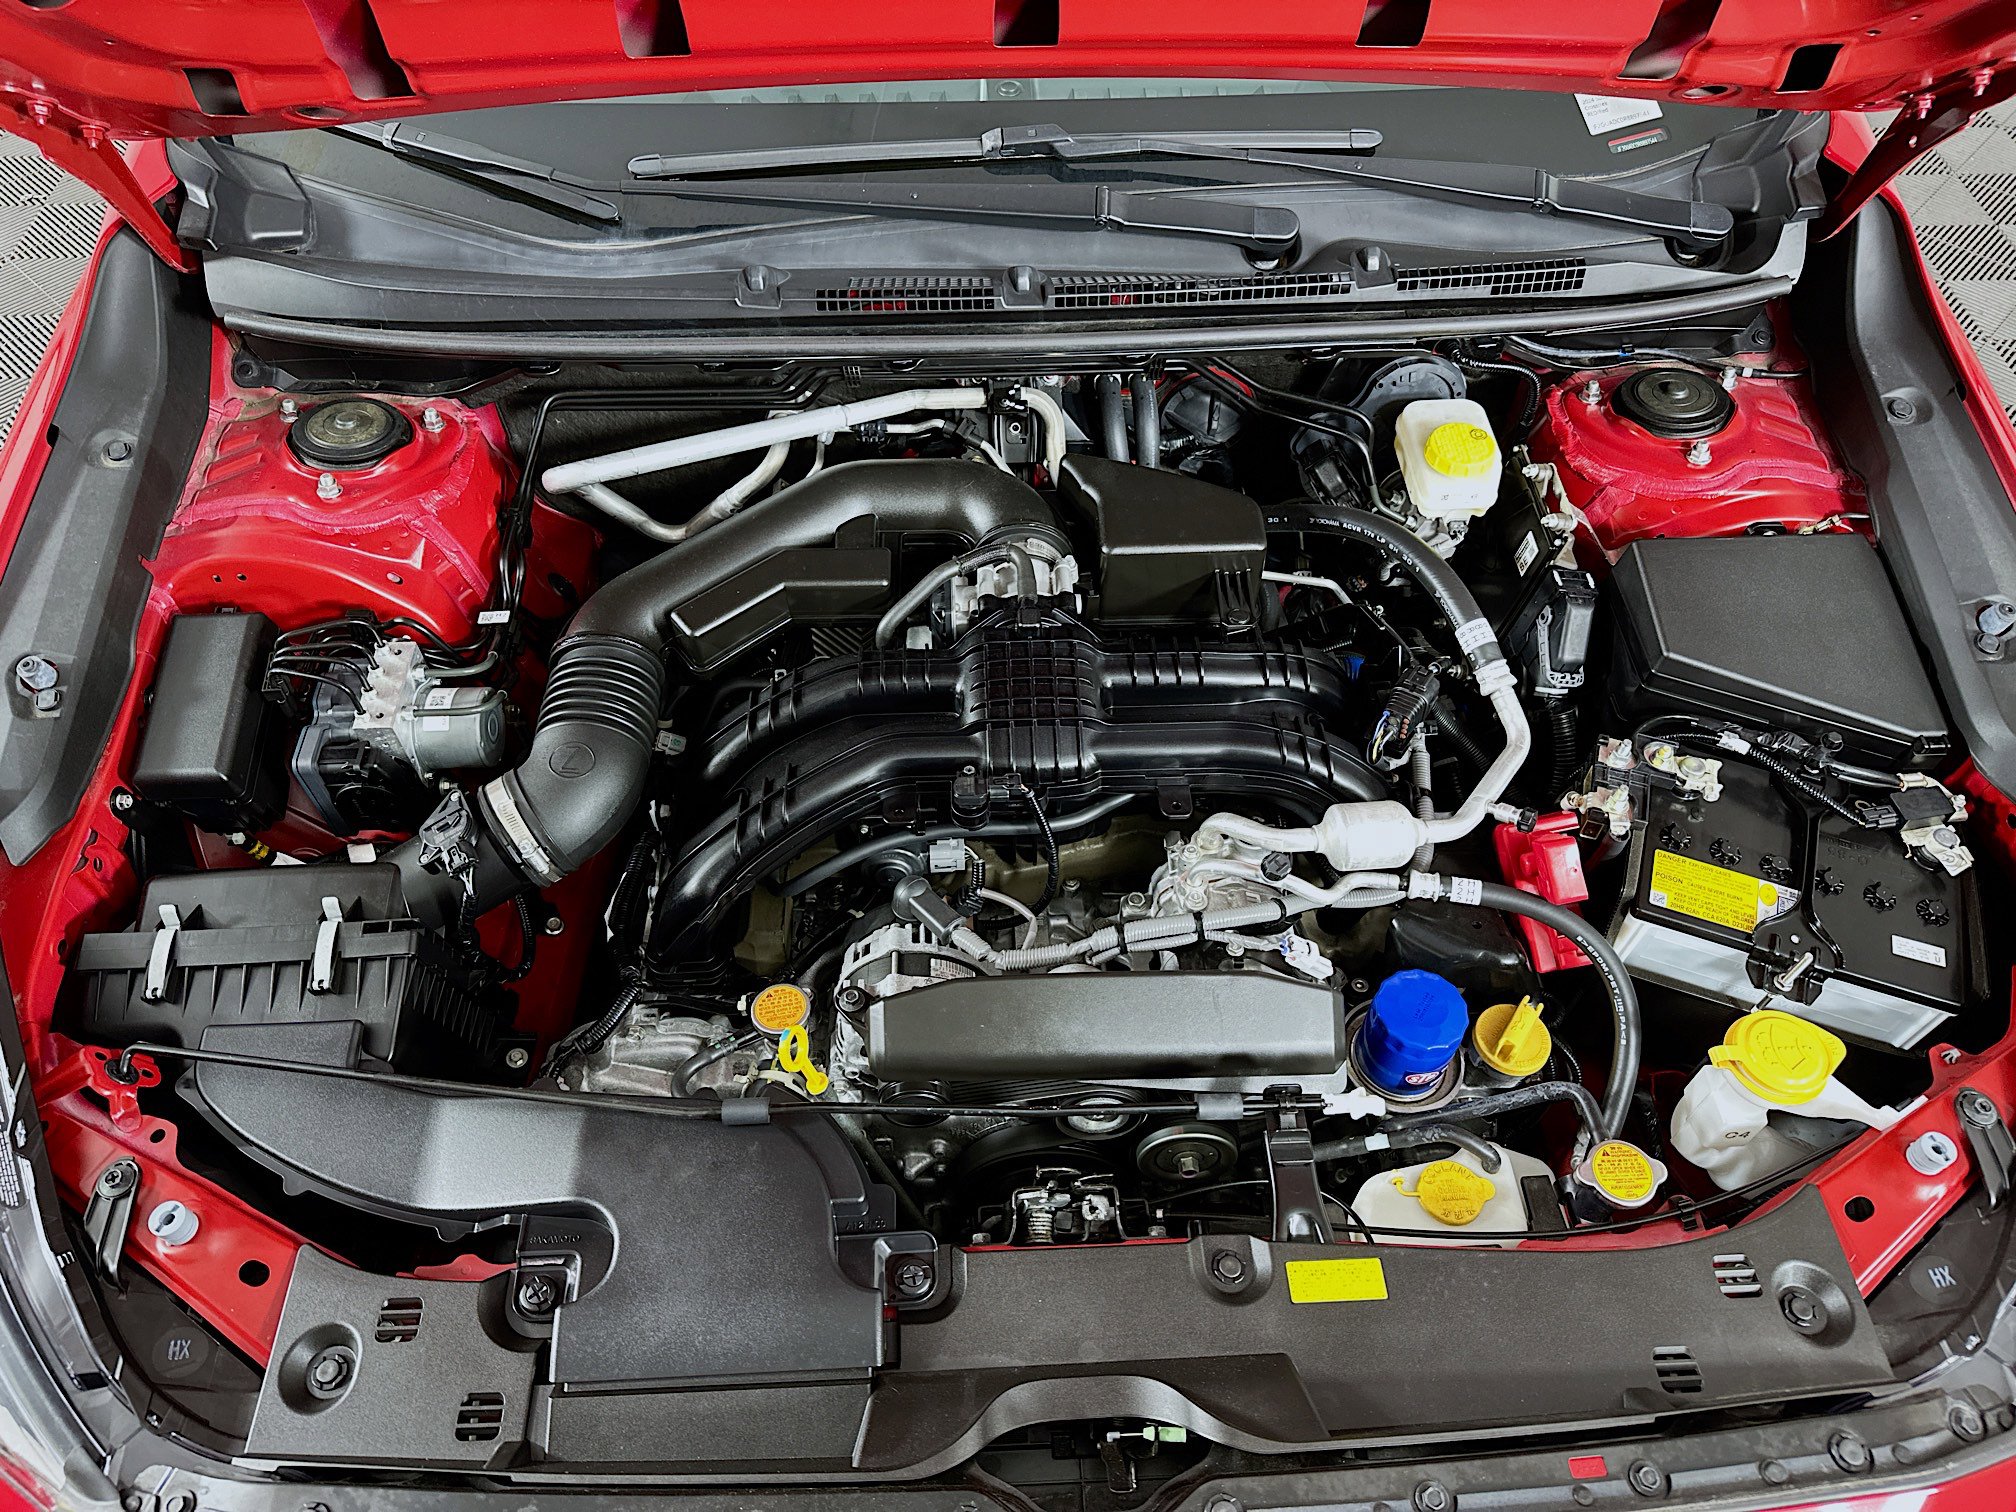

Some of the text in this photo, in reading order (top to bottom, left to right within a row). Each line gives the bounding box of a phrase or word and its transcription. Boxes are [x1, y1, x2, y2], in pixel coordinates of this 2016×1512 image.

[1342, 522, 1362, 533] ACVR
[1376, 535, 1386, 544] LP
[1657, 852, 1687, 865] DANGER
[1655, 872, 1684, 885] POISON
[1687, 881, 1706, 892] CAUSES
[1674, 892, 1686, 900] KEEP
[1670, 902, 1685, 910] 20HR
[1702, 911, 1715, 920] CCA
[1673, 897, 1687, 905] KEEP
[1730, 914, 1754, 925] CHILDREN
[1407, 1072, 1438, 1084] STP
[1725, 1131, 1750, 1139] C4
[1422, 1163, 1475, 1184] COOLANT
[1928, 1265, 1957, 1288] HX
[168, 1339, 191, 1360] HX
